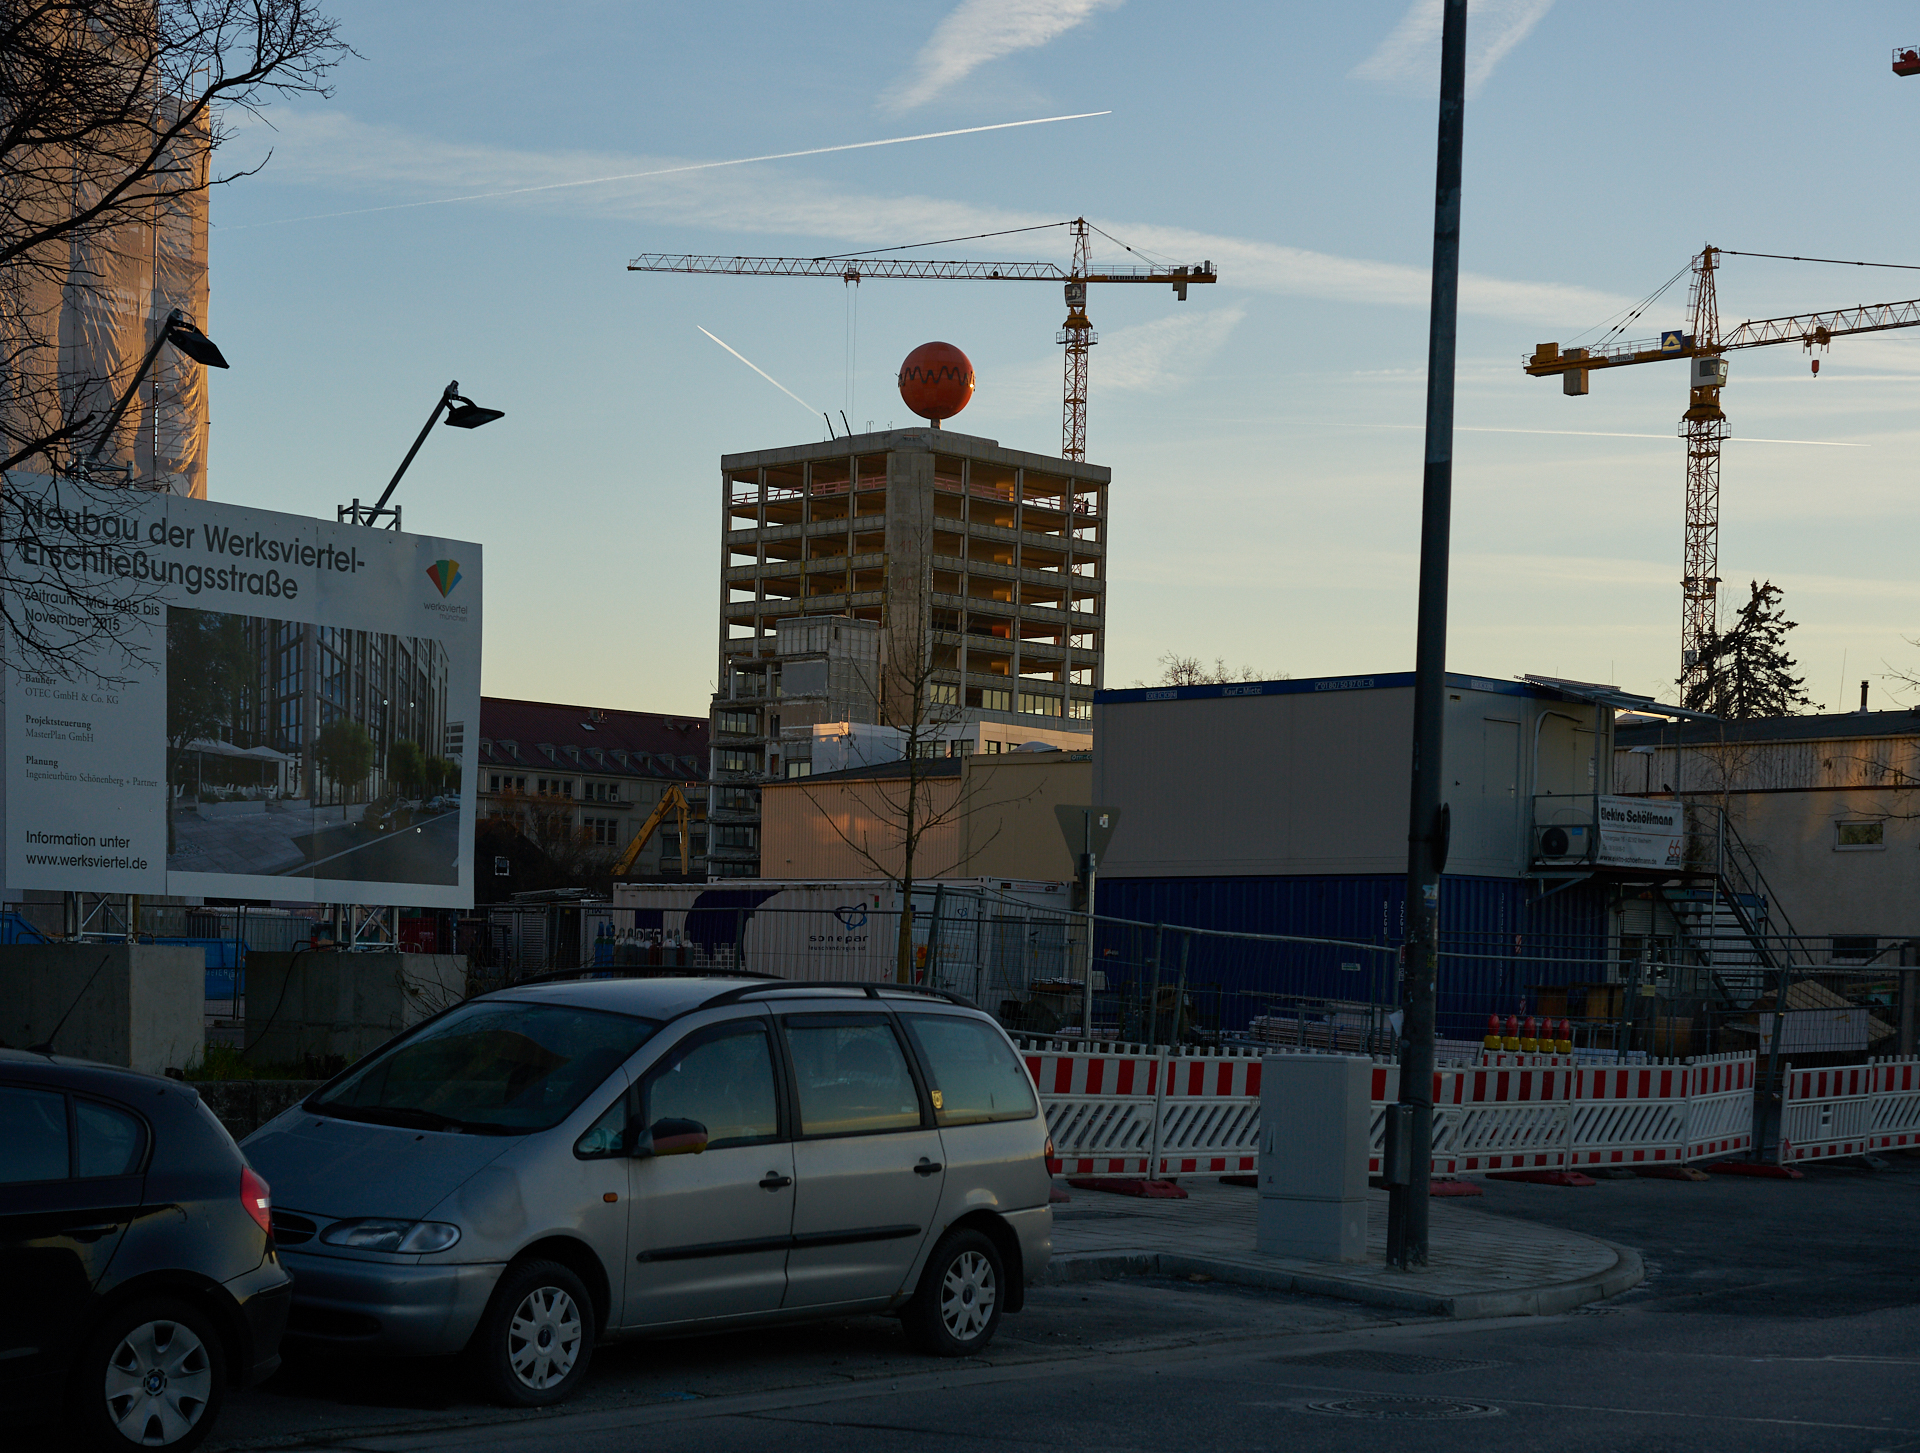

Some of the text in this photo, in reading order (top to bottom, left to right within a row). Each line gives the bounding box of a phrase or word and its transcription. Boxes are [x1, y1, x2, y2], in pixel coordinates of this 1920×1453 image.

[23, 500, 366, 573] Neubau der Werksviertel-
[23, 536, 298, 600] Erschließungsstraße
[86, 594, 109, 611] Mai
[112, 598, 139, 614] 2015
[143, 602, 160, 616] bis
[423, 602, 468, 615] werksviertel
[25, 608, 120, 632] November 2015
[439, 613, 468, 623] münchen
[1685, 652, 1697, 662] K2
[25, 674, 57, 684] Bauherr
[25, 687, 119, 704] OTEC GmbH & Co. KG
[25, 715, 92, 731] Projektsteuerung
[25, 728, 94, 743] MasterPlan GmbH
[25, 756, 59, 769] Planung
[25, 769, 78, 781] Ingenieurbüro
[79, 774, 124, 787] Schönenberg
[132, 777, 158, 787] Partner
[1601, 807, 1673, 826] Elektro Schöffmann
[26, 830, 131, 848] Information unter
[1668, 840, 1681, 857] 66
[26, 854, 148, 870] www.werksviertel.de
[809, 935, 869, 944] sonepar
